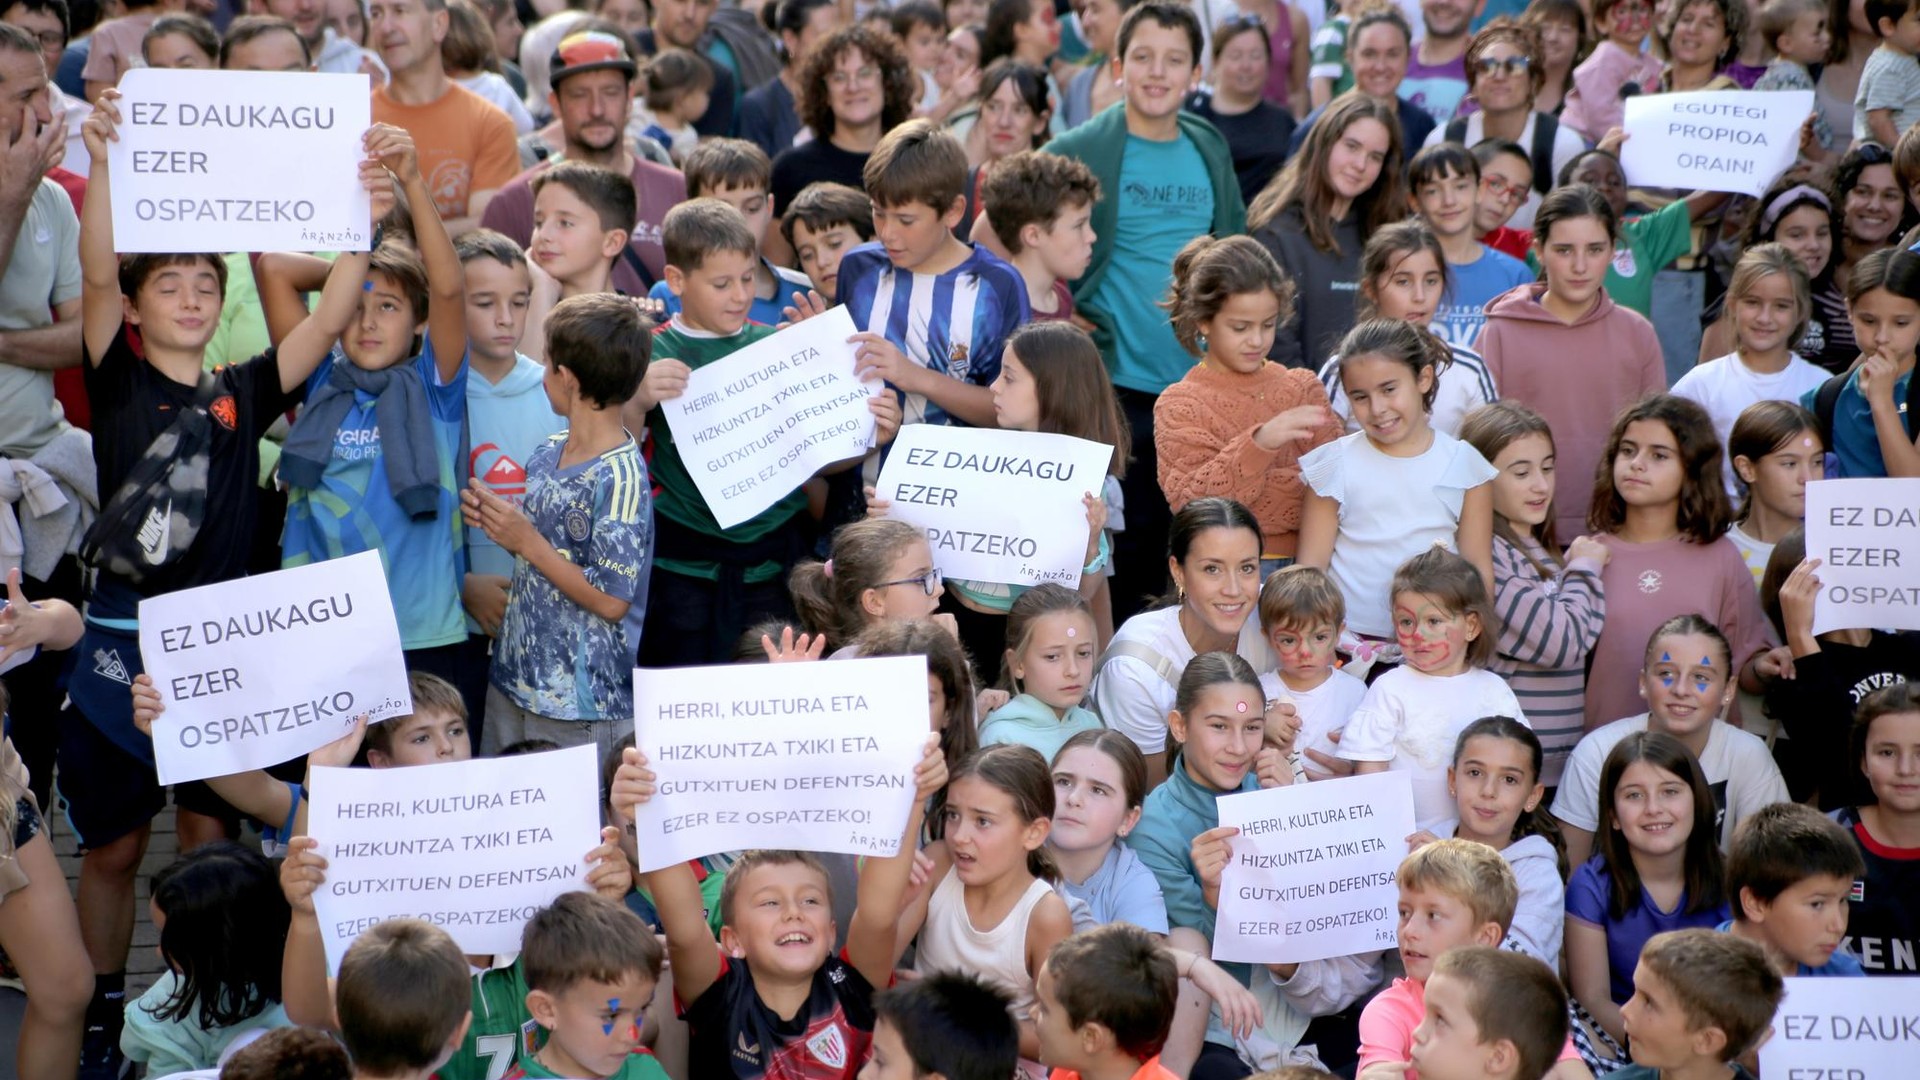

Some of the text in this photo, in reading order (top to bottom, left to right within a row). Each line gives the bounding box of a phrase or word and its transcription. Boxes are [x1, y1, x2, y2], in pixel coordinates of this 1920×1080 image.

[132, 102, 334, 129] EZ DAUKAGU
[1672, 103, 1767, 120] EGUTEGI
[1668, 123, 1768, 146] PROPIOA
[132, 151, 208, 174] EZER
[1677, 153, 1754, 174] ORAIN!
[135, 198, 315, 222] OSPATZEKO
[682, 346, 820, 416] HERRI, KULTURA ETA
[692, 372, 838, 445] HIZKUNTZA TXIKI ETA
[334, 426, 380, 445] GARA
[706, 387, 870, 473] GUTXITUEN DEFENTSAN
[721, 418, 861, 500] EZER EZ OSPATZEKO!
[906, 448, 1074, 482] EZ DAUKAGU
[895, 483, 958, 508] EZER
[137, 506, 162, 553] NIKE
[1830, 507, 1920, 527] EZ DA
[926, 528, 1038, 558] PATZEKO
[1829, 548, 1900, 567] EZER
[160, 592, 353, 652] EZ DAUKAGU
[171, 667, 243, 701] EZER
[180, 691, 354, 749] OSPATZEKO
[345, 698, 406, 726] ARNZADI
[658, 694, 868, 720] HERRI, KULTURA ETA
[660, 736, 879, 760] HIZKUNTZA TXIKI ETA
[660, 774, 905, 796] GUTXITUEN DEFENTSAN
[337, 788, 546, 820] HERRI, KULTURA ETA
[662, 809, 872, 834] EZER EZ OSPATZEKO!
[1242, 804, 1374, 836] HERRI, KULTURA ETA
[335, 827, 553, 858] HIZKUNTZA TXIKI ETA
[850, 831, 904, 850] ARANZ
[1241, 838, 1386, 868] HIZKUNTZA TXIKI ETA
[332, 864, 577, 896] GUTXITUEN DEFENTSAN
[1239, 871, 1396, 902] GUTXITUEN DEFENTSA
[1238, 907, 1388, 936] EZER EZ OSPATZEKO!
[1839, 935, 1920, 971] KEN
[1784, 1015, 1920, 1041] EZ DAUK
